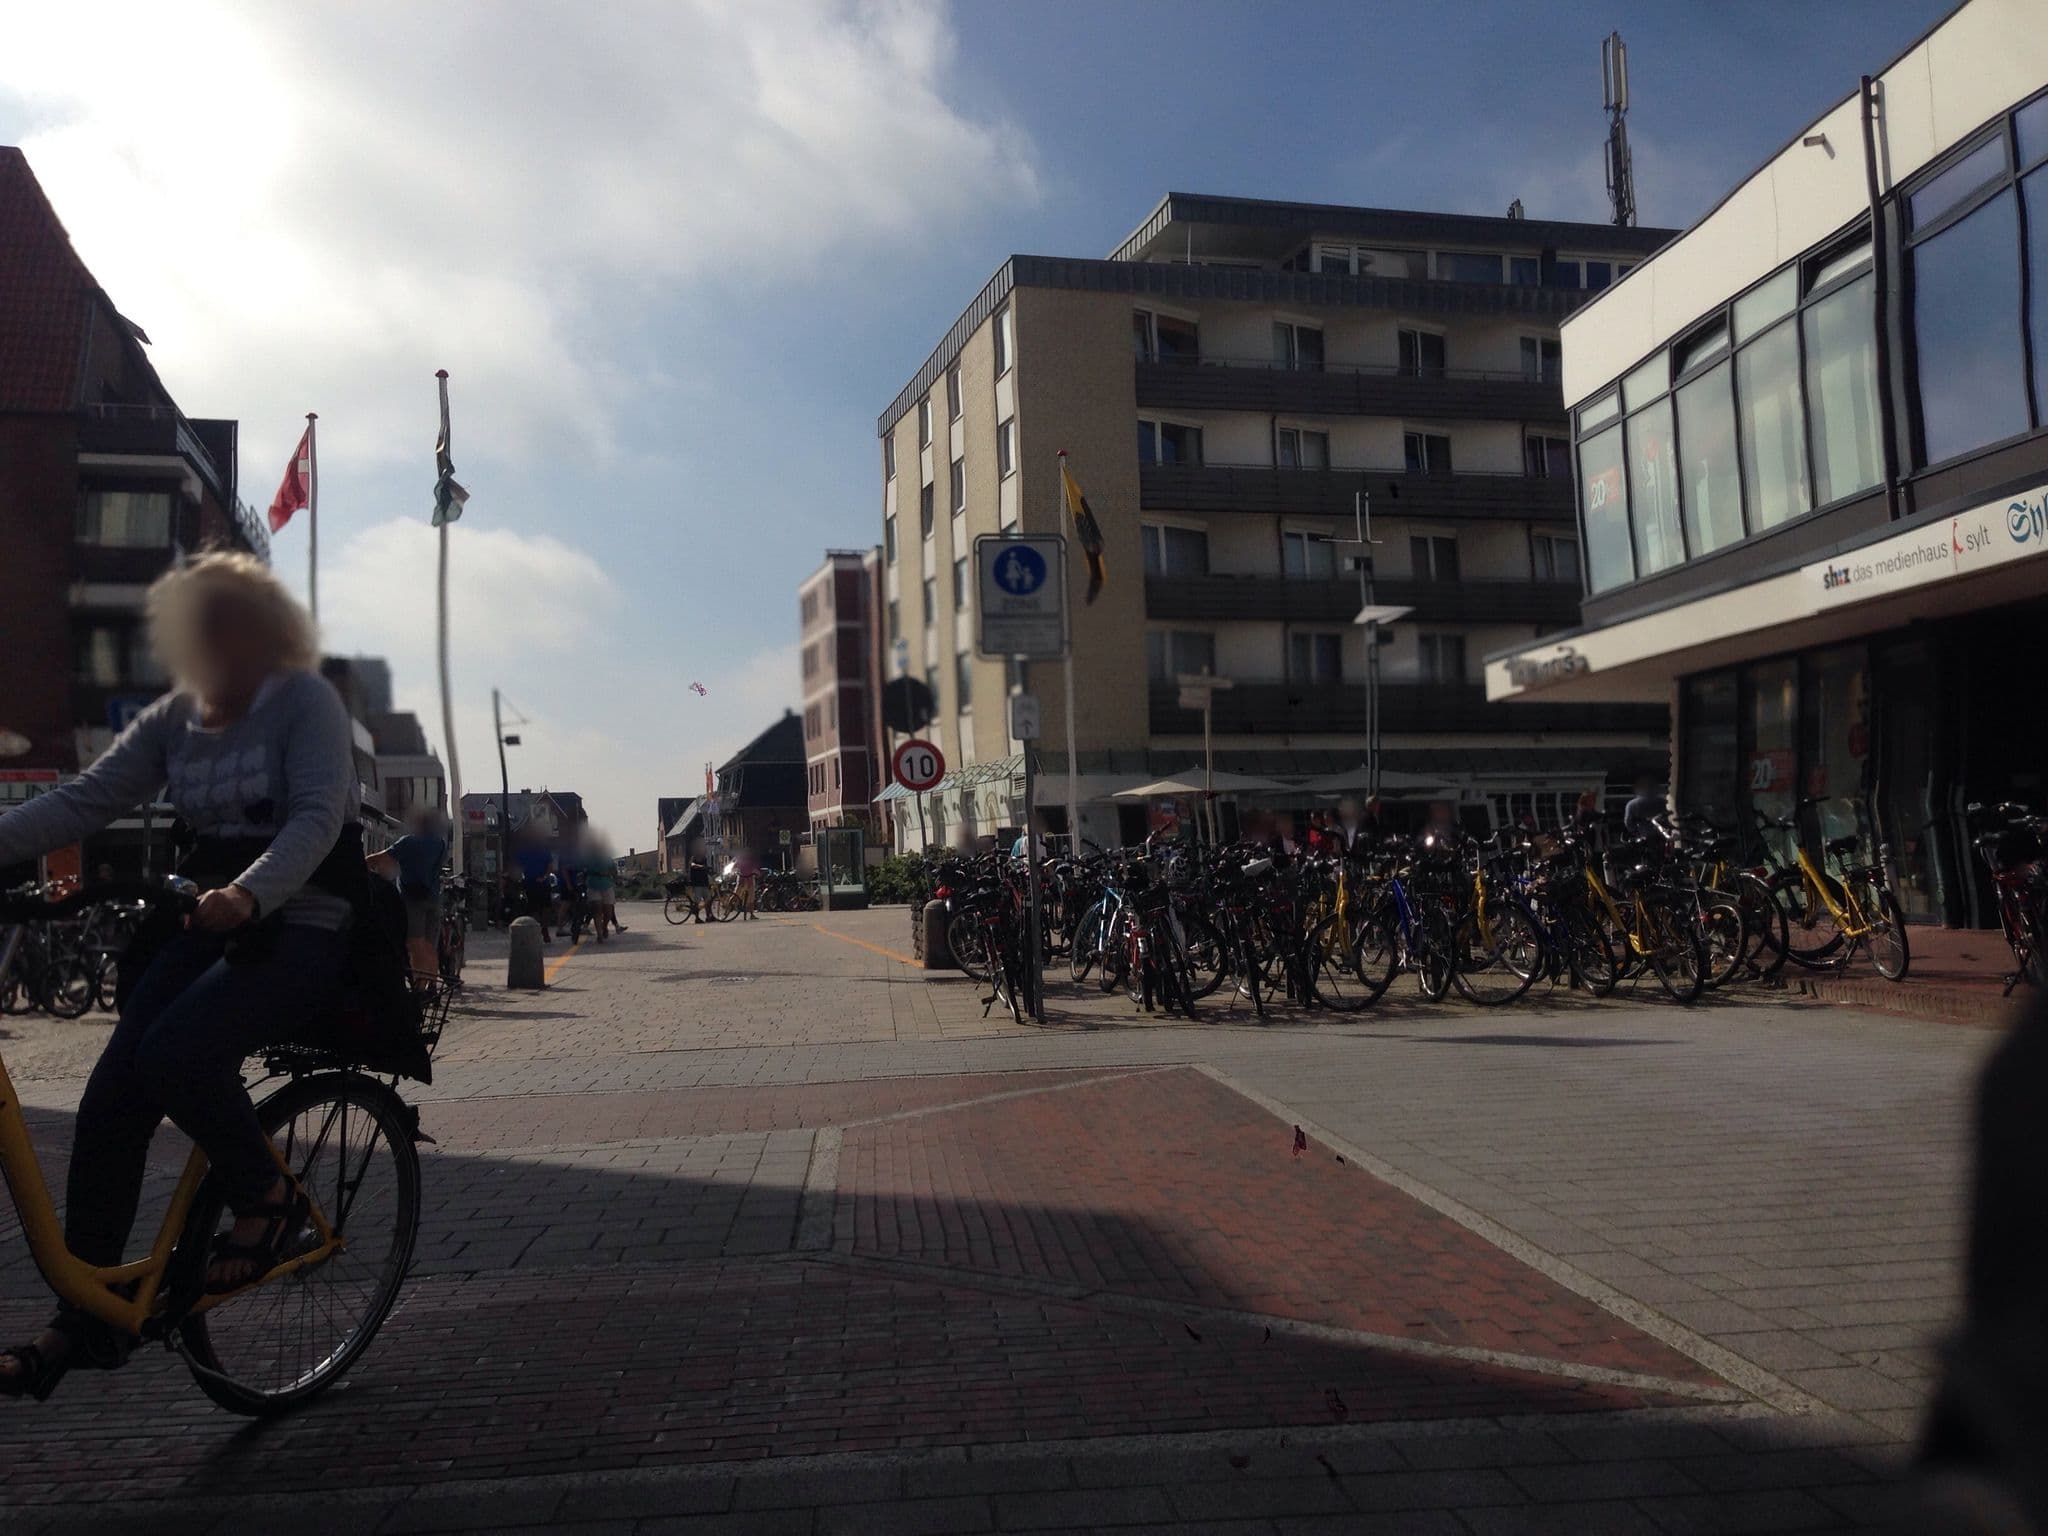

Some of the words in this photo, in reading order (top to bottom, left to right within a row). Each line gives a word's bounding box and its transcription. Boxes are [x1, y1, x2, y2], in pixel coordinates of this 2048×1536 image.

[2007, 493, 2048, 545] Sy
[1853, 564, 1873, 583] das
[1877, 542, 1949, 574] medienhaus
[1966, 524, 1992, 552] sylt
[905, 754, 934, 780] 10
